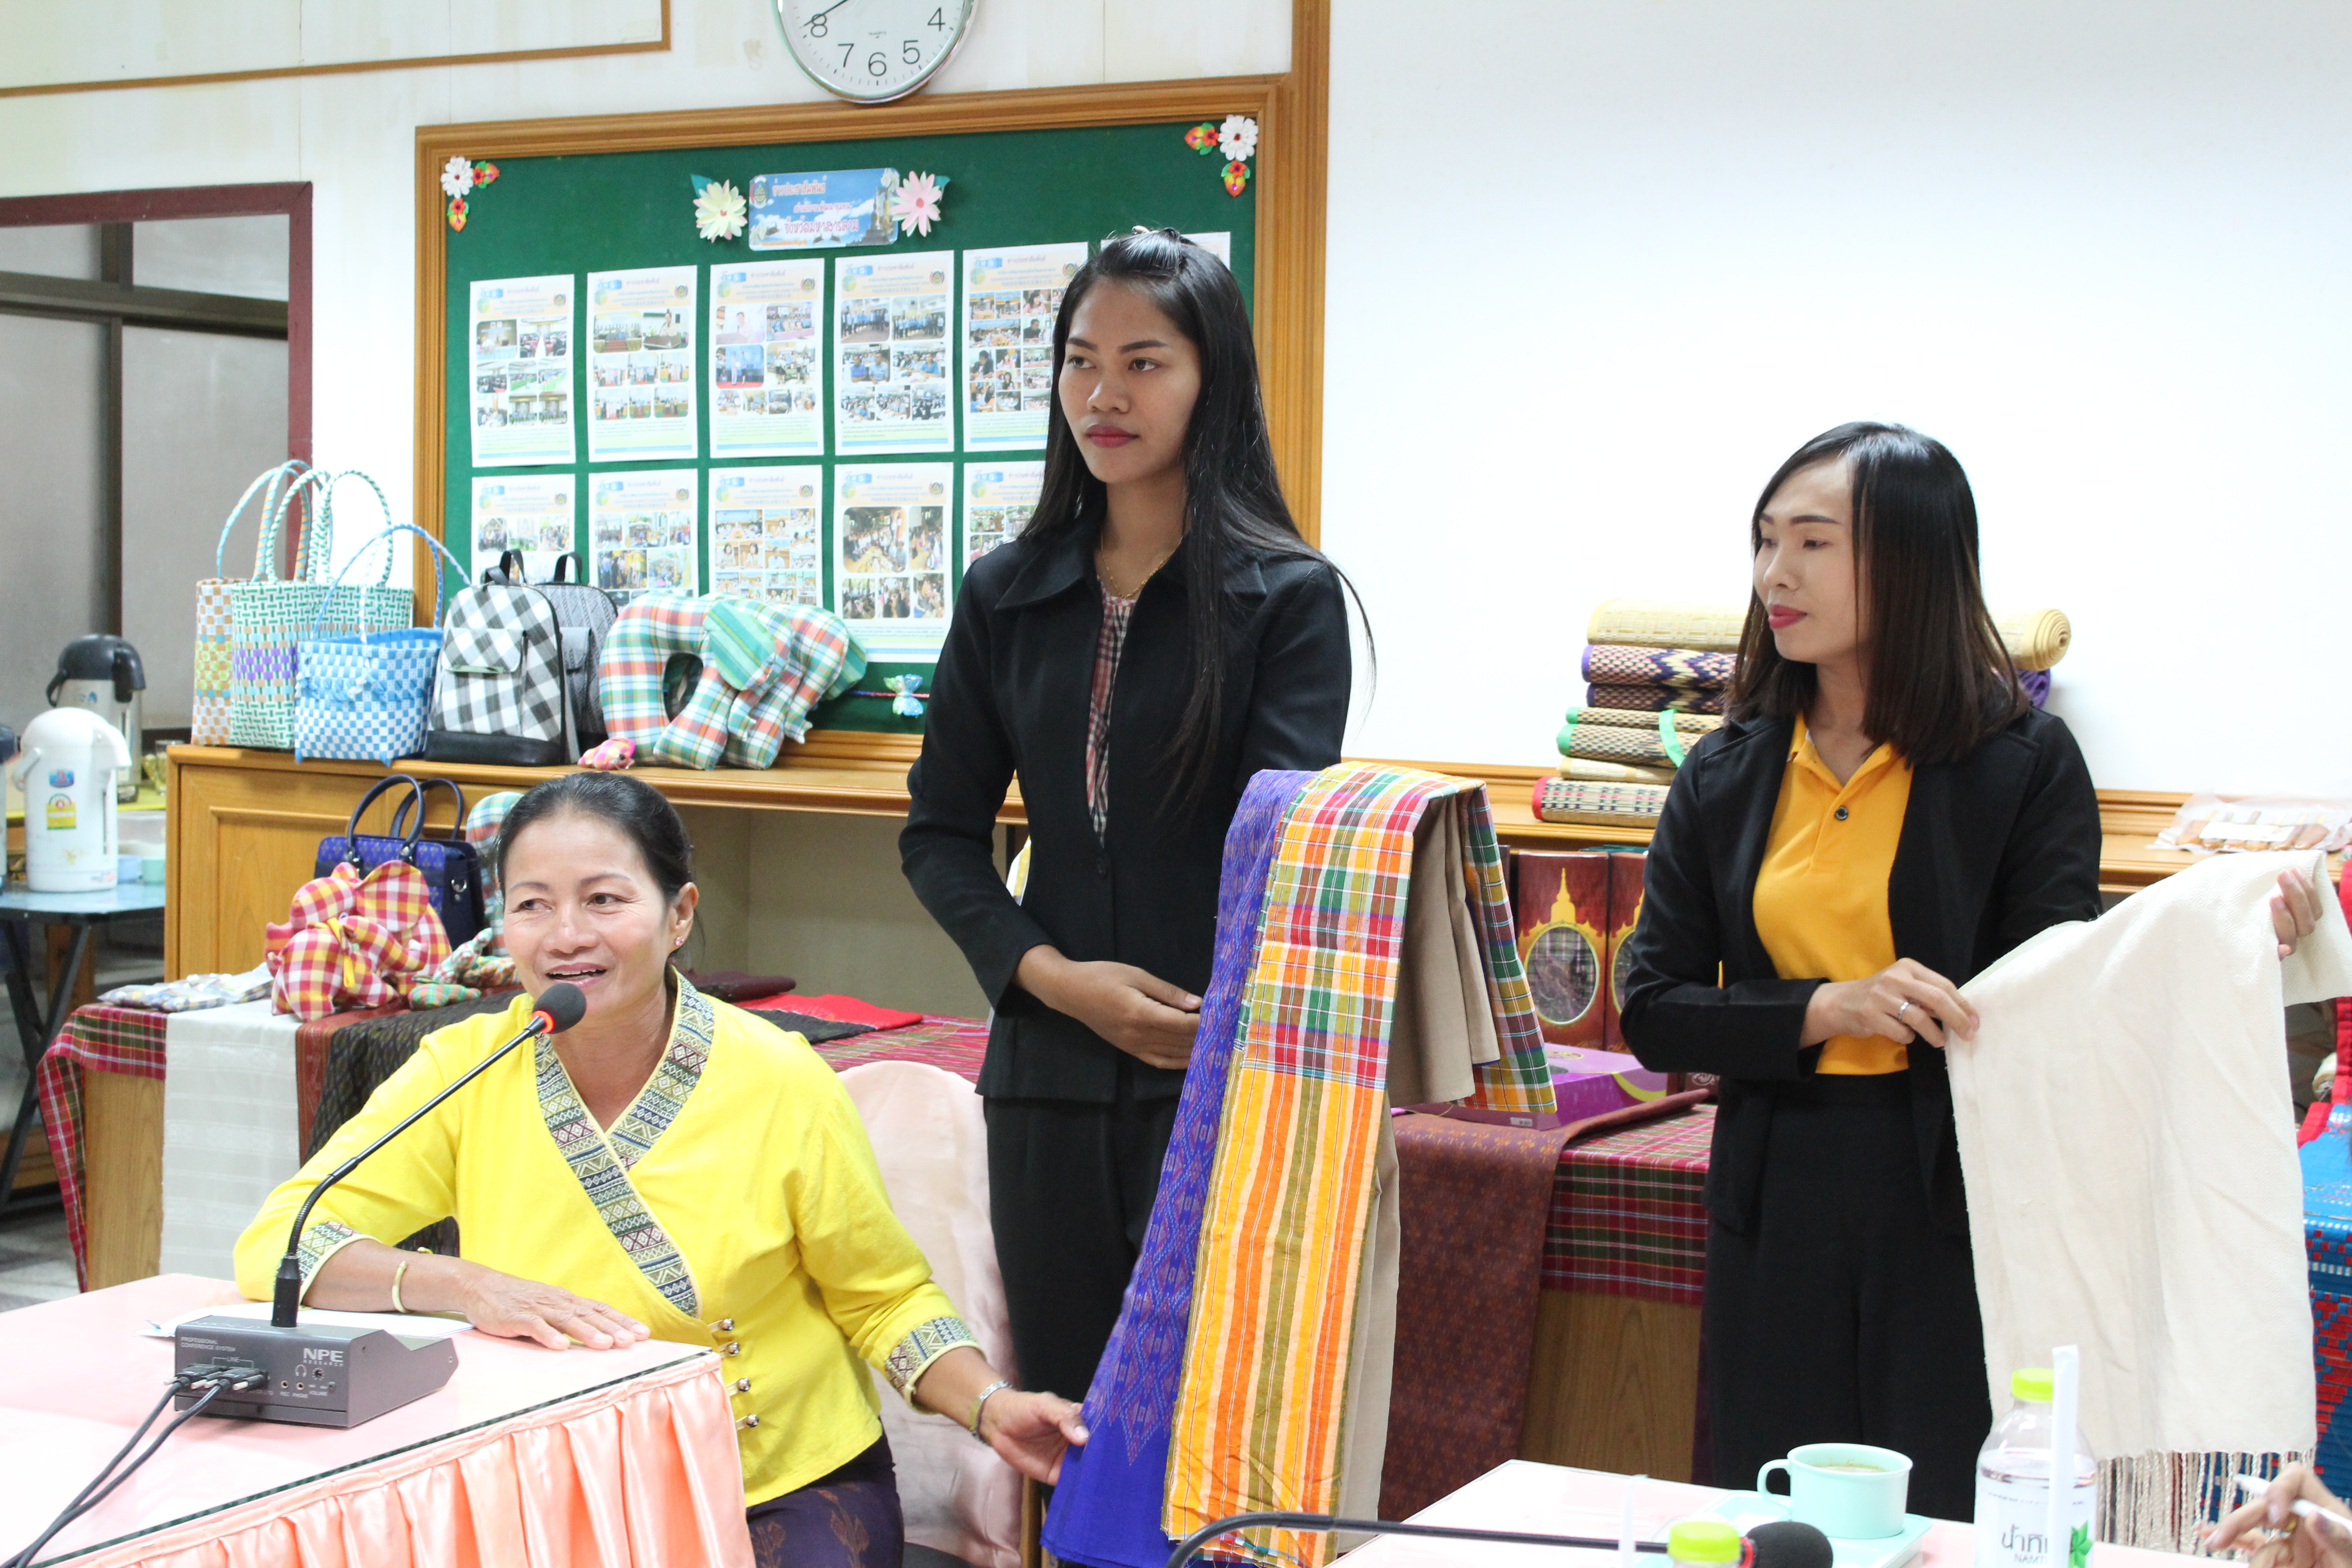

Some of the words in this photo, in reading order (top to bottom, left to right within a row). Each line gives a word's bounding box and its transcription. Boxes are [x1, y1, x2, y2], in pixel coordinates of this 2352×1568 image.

[811, 13, 828, 37] 8
[927, 7, 946, 31] 4
[838, 43, 854, 68] 7
[868, 52, 887, 76] 6
[903, 40, 920, 64] 5
[304, 1348, 343, 1362] NPE
